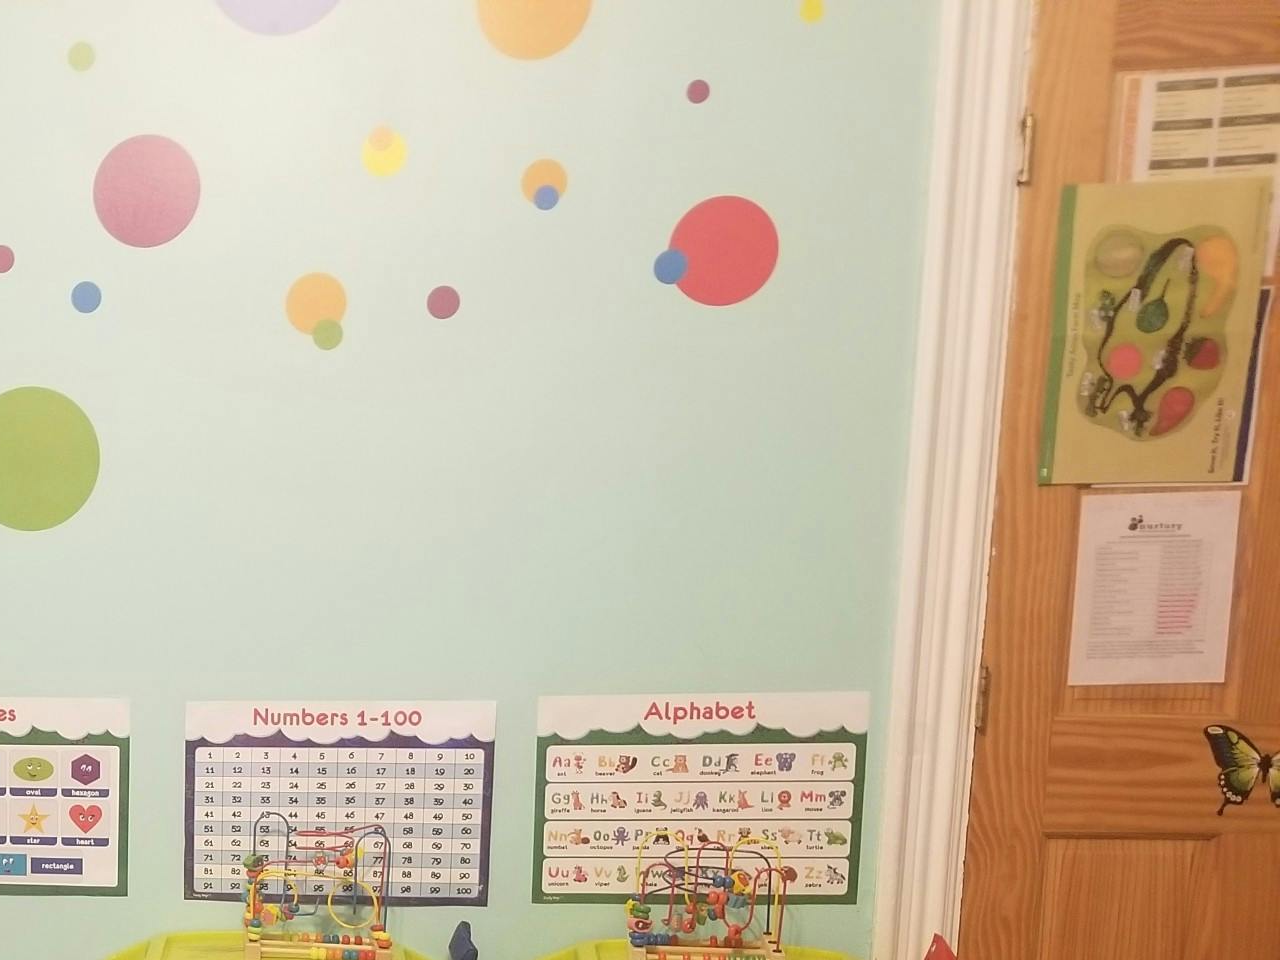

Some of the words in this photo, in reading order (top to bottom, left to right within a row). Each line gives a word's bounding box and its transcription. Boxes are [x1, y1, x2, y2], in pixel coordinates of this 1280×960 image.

[254, 708, 348, 725] Numbers
[357, 711, 422, 726] 1-100
[644, 701, 755, 725] Alphabet
